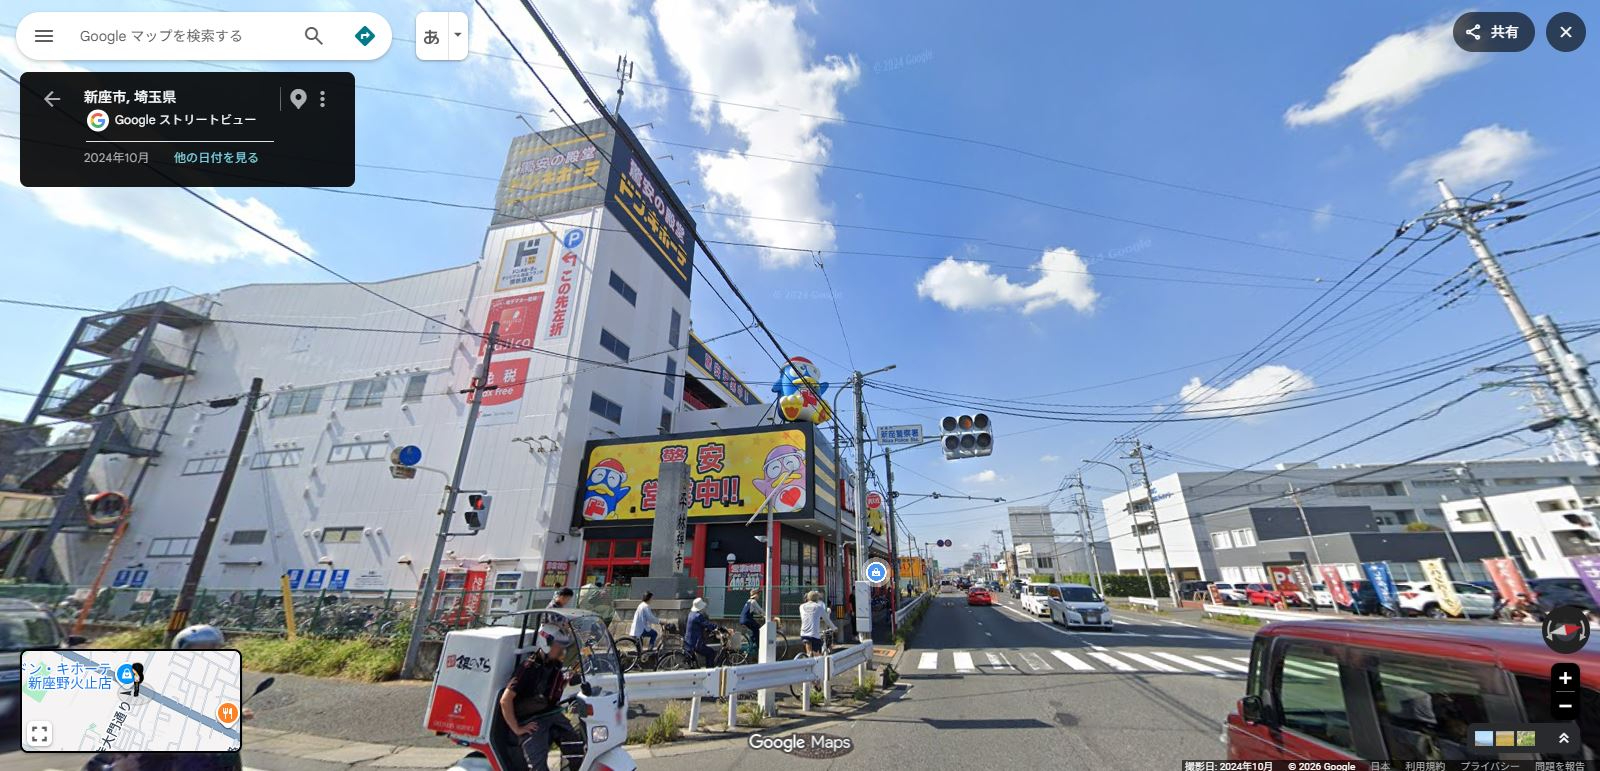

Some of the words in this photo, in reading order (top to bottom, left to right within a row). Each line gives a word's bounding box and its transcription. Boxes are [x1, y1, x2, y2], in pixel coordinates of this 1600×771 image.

[549, 269, 574, 337] この先左折
